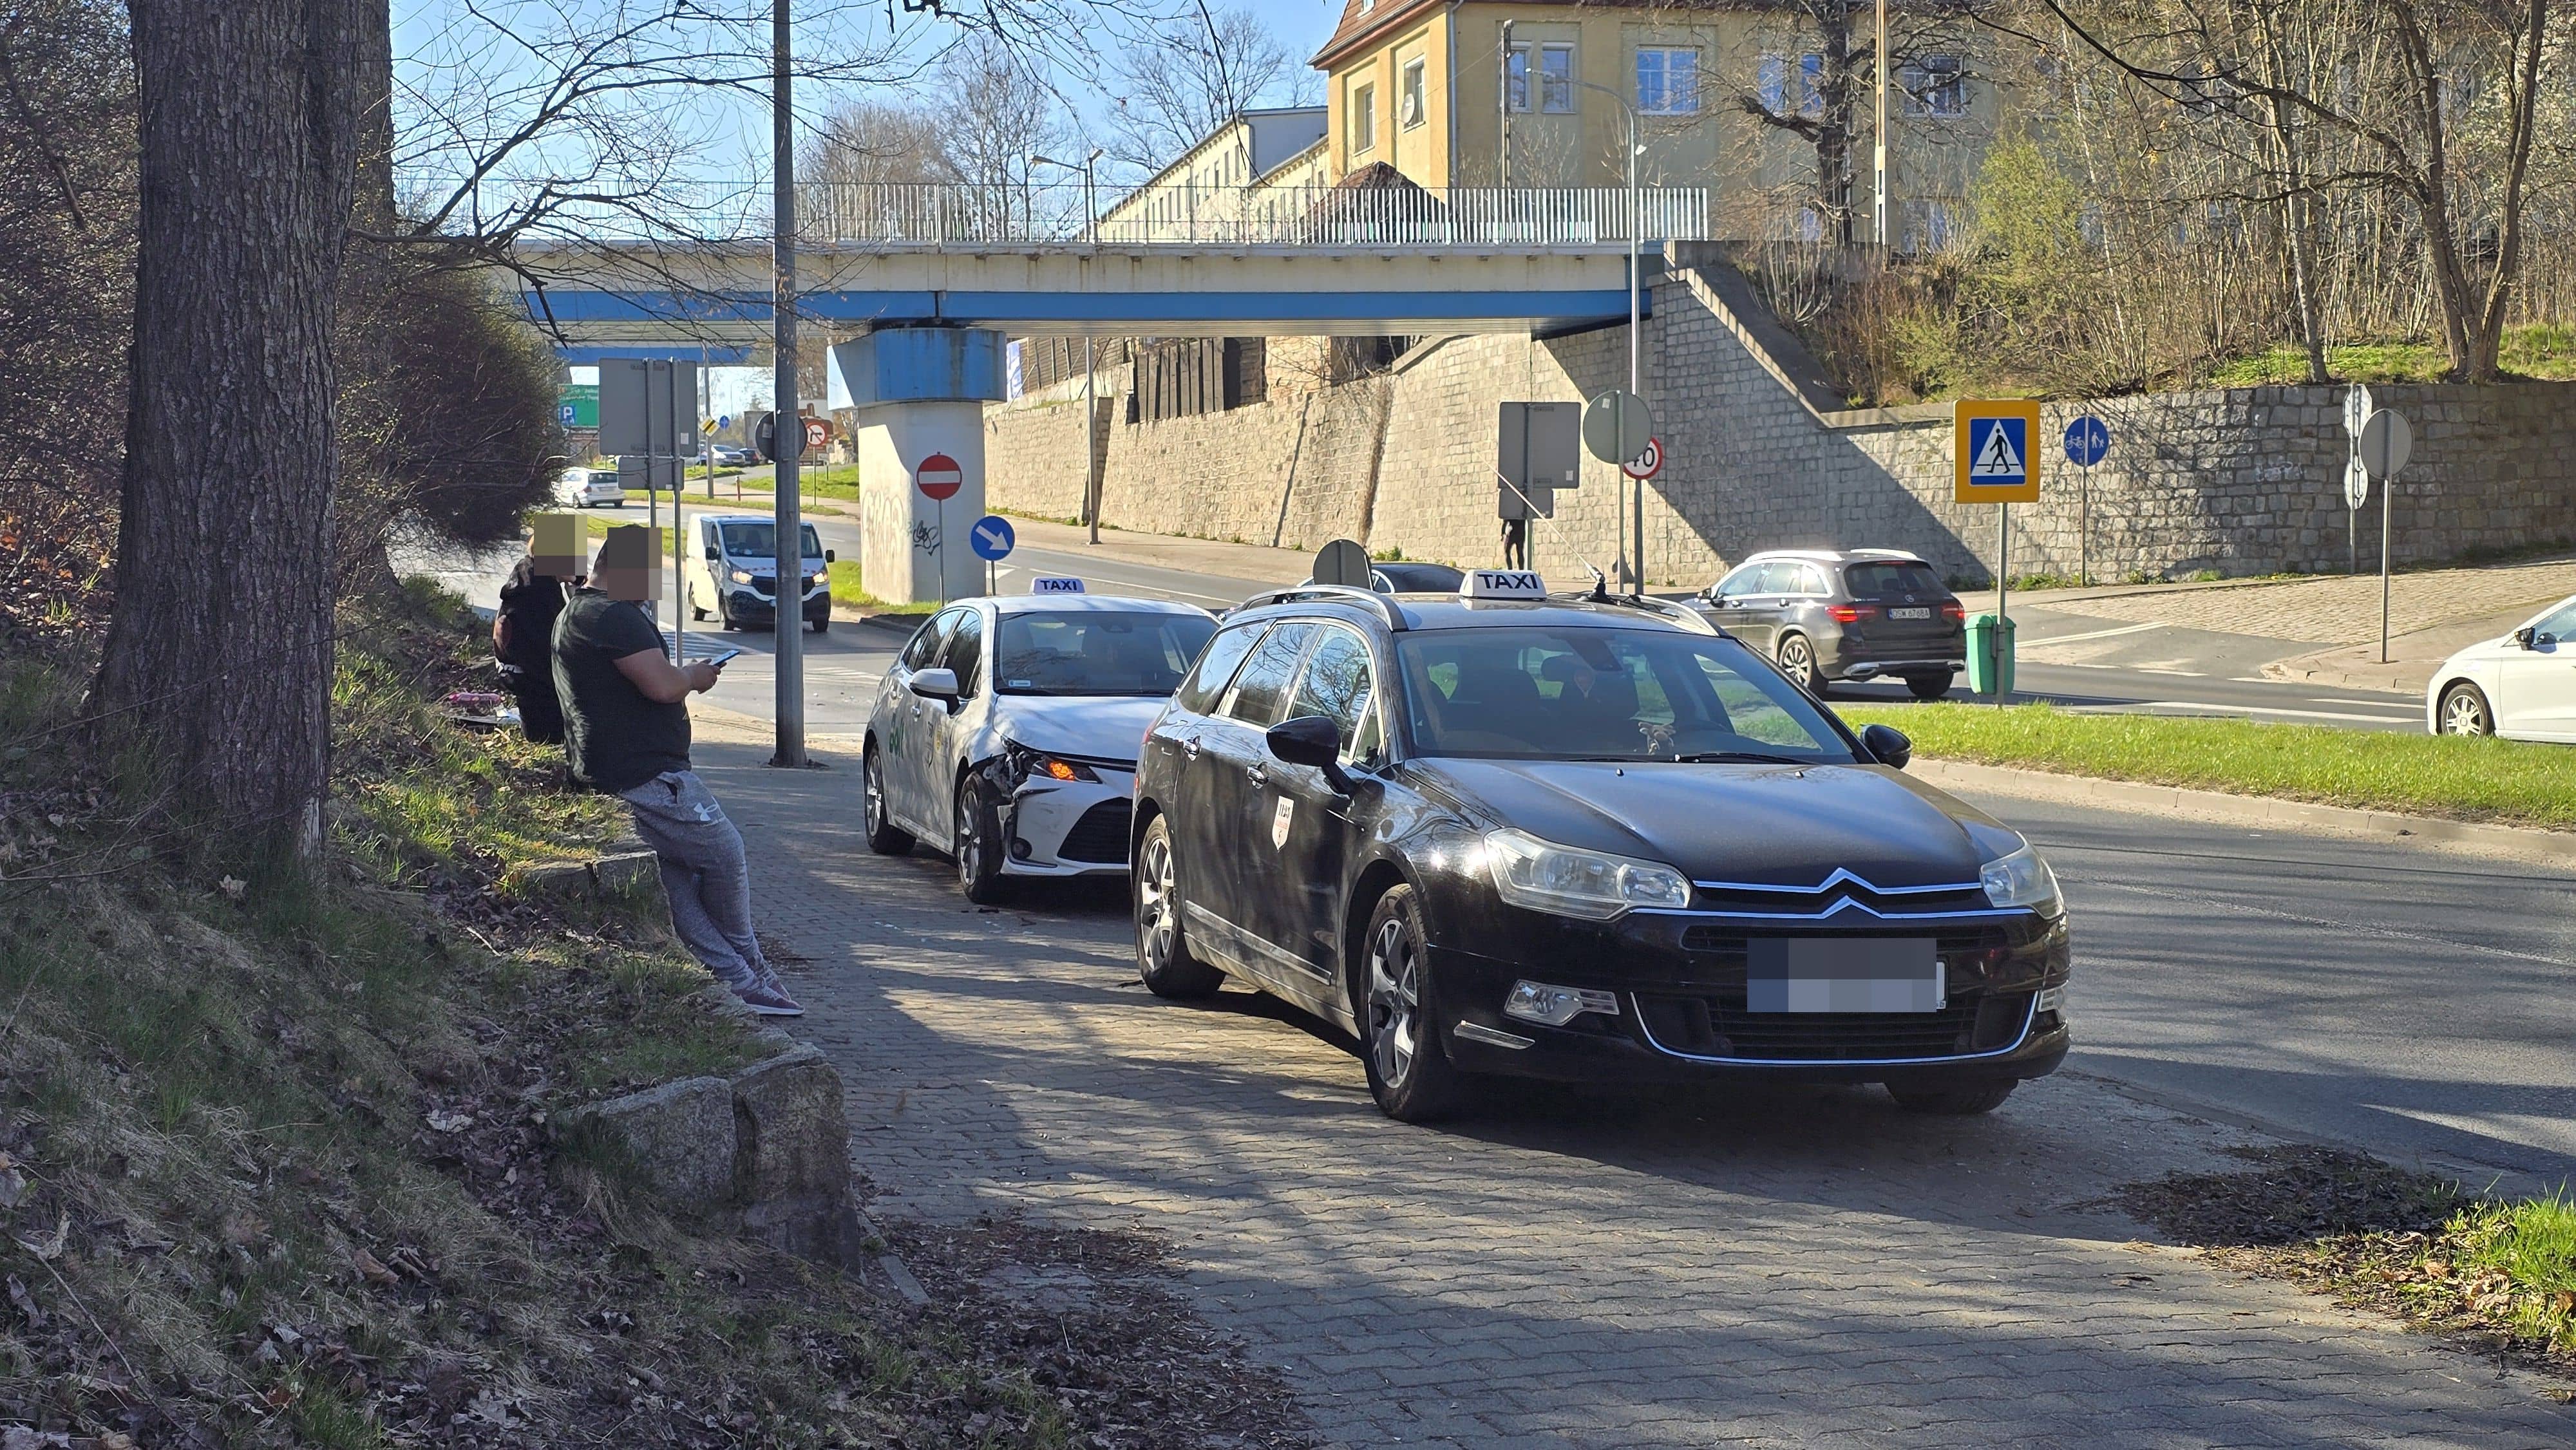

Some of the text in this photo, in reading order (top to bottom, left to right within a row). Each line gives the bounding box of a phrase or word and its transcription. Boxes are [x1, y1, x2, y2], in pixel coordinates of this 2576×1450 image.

[563, 406, 573, 419] P
[1040, 580, 1077, 590] TAXI
[1477, 574, 1539, 589] TAXI
